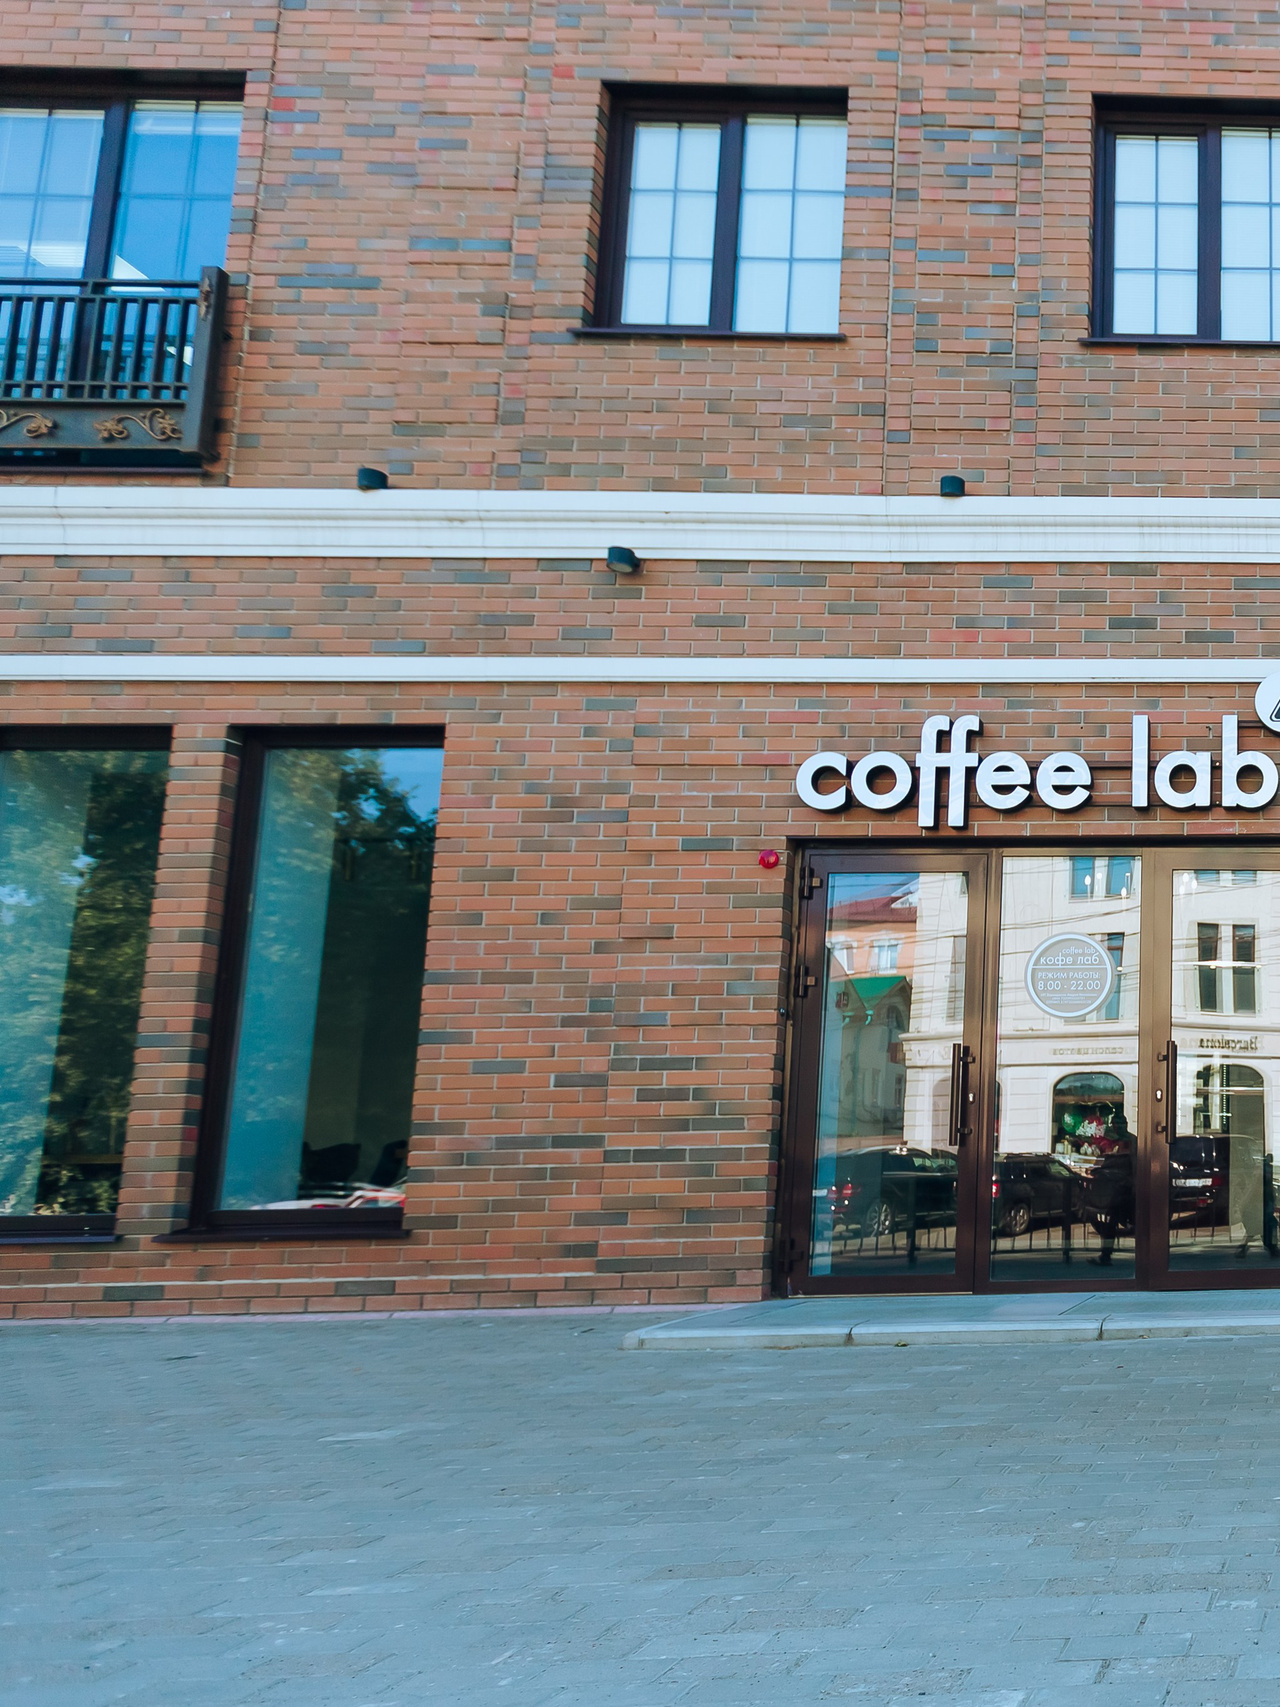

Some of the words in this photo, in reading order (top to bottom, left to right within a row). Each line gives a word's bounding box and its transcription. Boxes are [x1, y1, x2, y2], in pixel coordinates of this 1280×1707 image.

[796, 714, 1095, 829] coffee
[1132, 714, 1279, 810] lab
[1062, 946, 1083, 955] coffee
[1084, 946, 1096, 954] lab
[1040, 952, 1073, 967] кофе
[1077, 952, 1099, 965] лаб
[1038, 971, 1067, 979] РЕЖИМ
[1069, 971, 1101, 979] РАБОТЫ:
[1038, 980, 1061, 990] 8.00
[1070, 980, 1101, 990] 22.00
